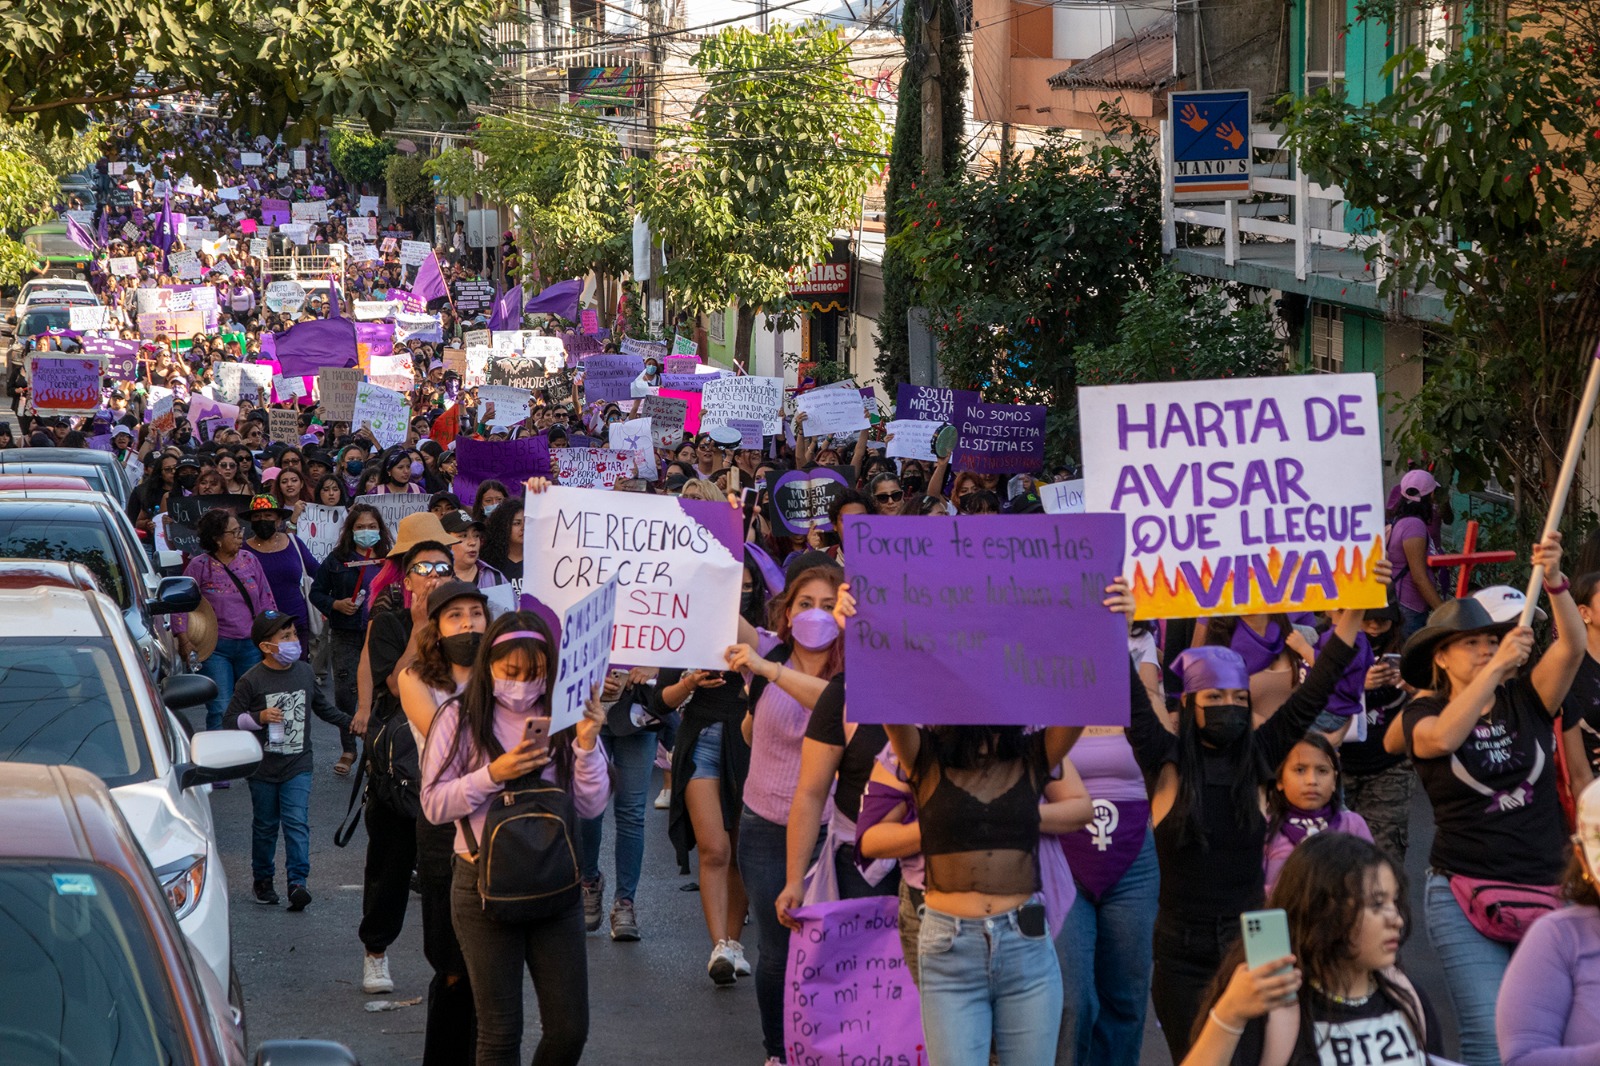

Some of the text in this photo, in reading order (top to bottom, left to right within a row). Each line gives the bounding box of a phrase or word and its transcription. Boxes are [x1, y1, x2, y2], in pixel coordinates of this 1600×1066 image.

[1178, 159, 1247, 175] MANO'S
[909, 398, 954, 414] MAESTR
[918, 386, 954, 400] SOY LA
[919, 412, 950, 421] DE LAS
[990, 410, 1031, 422] SOMOS
[1117, 394, 1366, 451] HARTA DE
[962, 422, 1040, 438] ANTISISTEMA
[960, 437, 1034, 452] EL SISTEMA ES
[791, 486, 826, 500] MUJER!
[1110, 457, 1312, 511] AVISAR
[172, 502, 190, 524] Ya
[788, 500, 798, 508] NO
[800, 499, 811, 508] ME
[552, 508, 709, 554] MERECEMOS
[850, 520, 1094, 564] Porque te espantas
[1130, 503, 1373, 557] QUE LLEGUE
[553, 556, 673, 588] CRECER
[1179, 549, 1339, 609] VIVA
[628, 589, 690, 619] SIN
[851, 574, 888, 605] Por
[903, 573, 932, 607] las
[940, 584, 974, 614] que
[854, 620, 892, 650] Por
[1475, 724, 1506, 738] NO NOS
[839, 914, 860, 938] mi
[794, 949, 825, 980] Por
[836, 955, 858, 974] mi
[792, 981, 819, 1008] Por
[834, 982, 858, 1004] mi
[792, 1011, 822, 1038] Por
[1330, 1025, 1416, 1066] BT21
